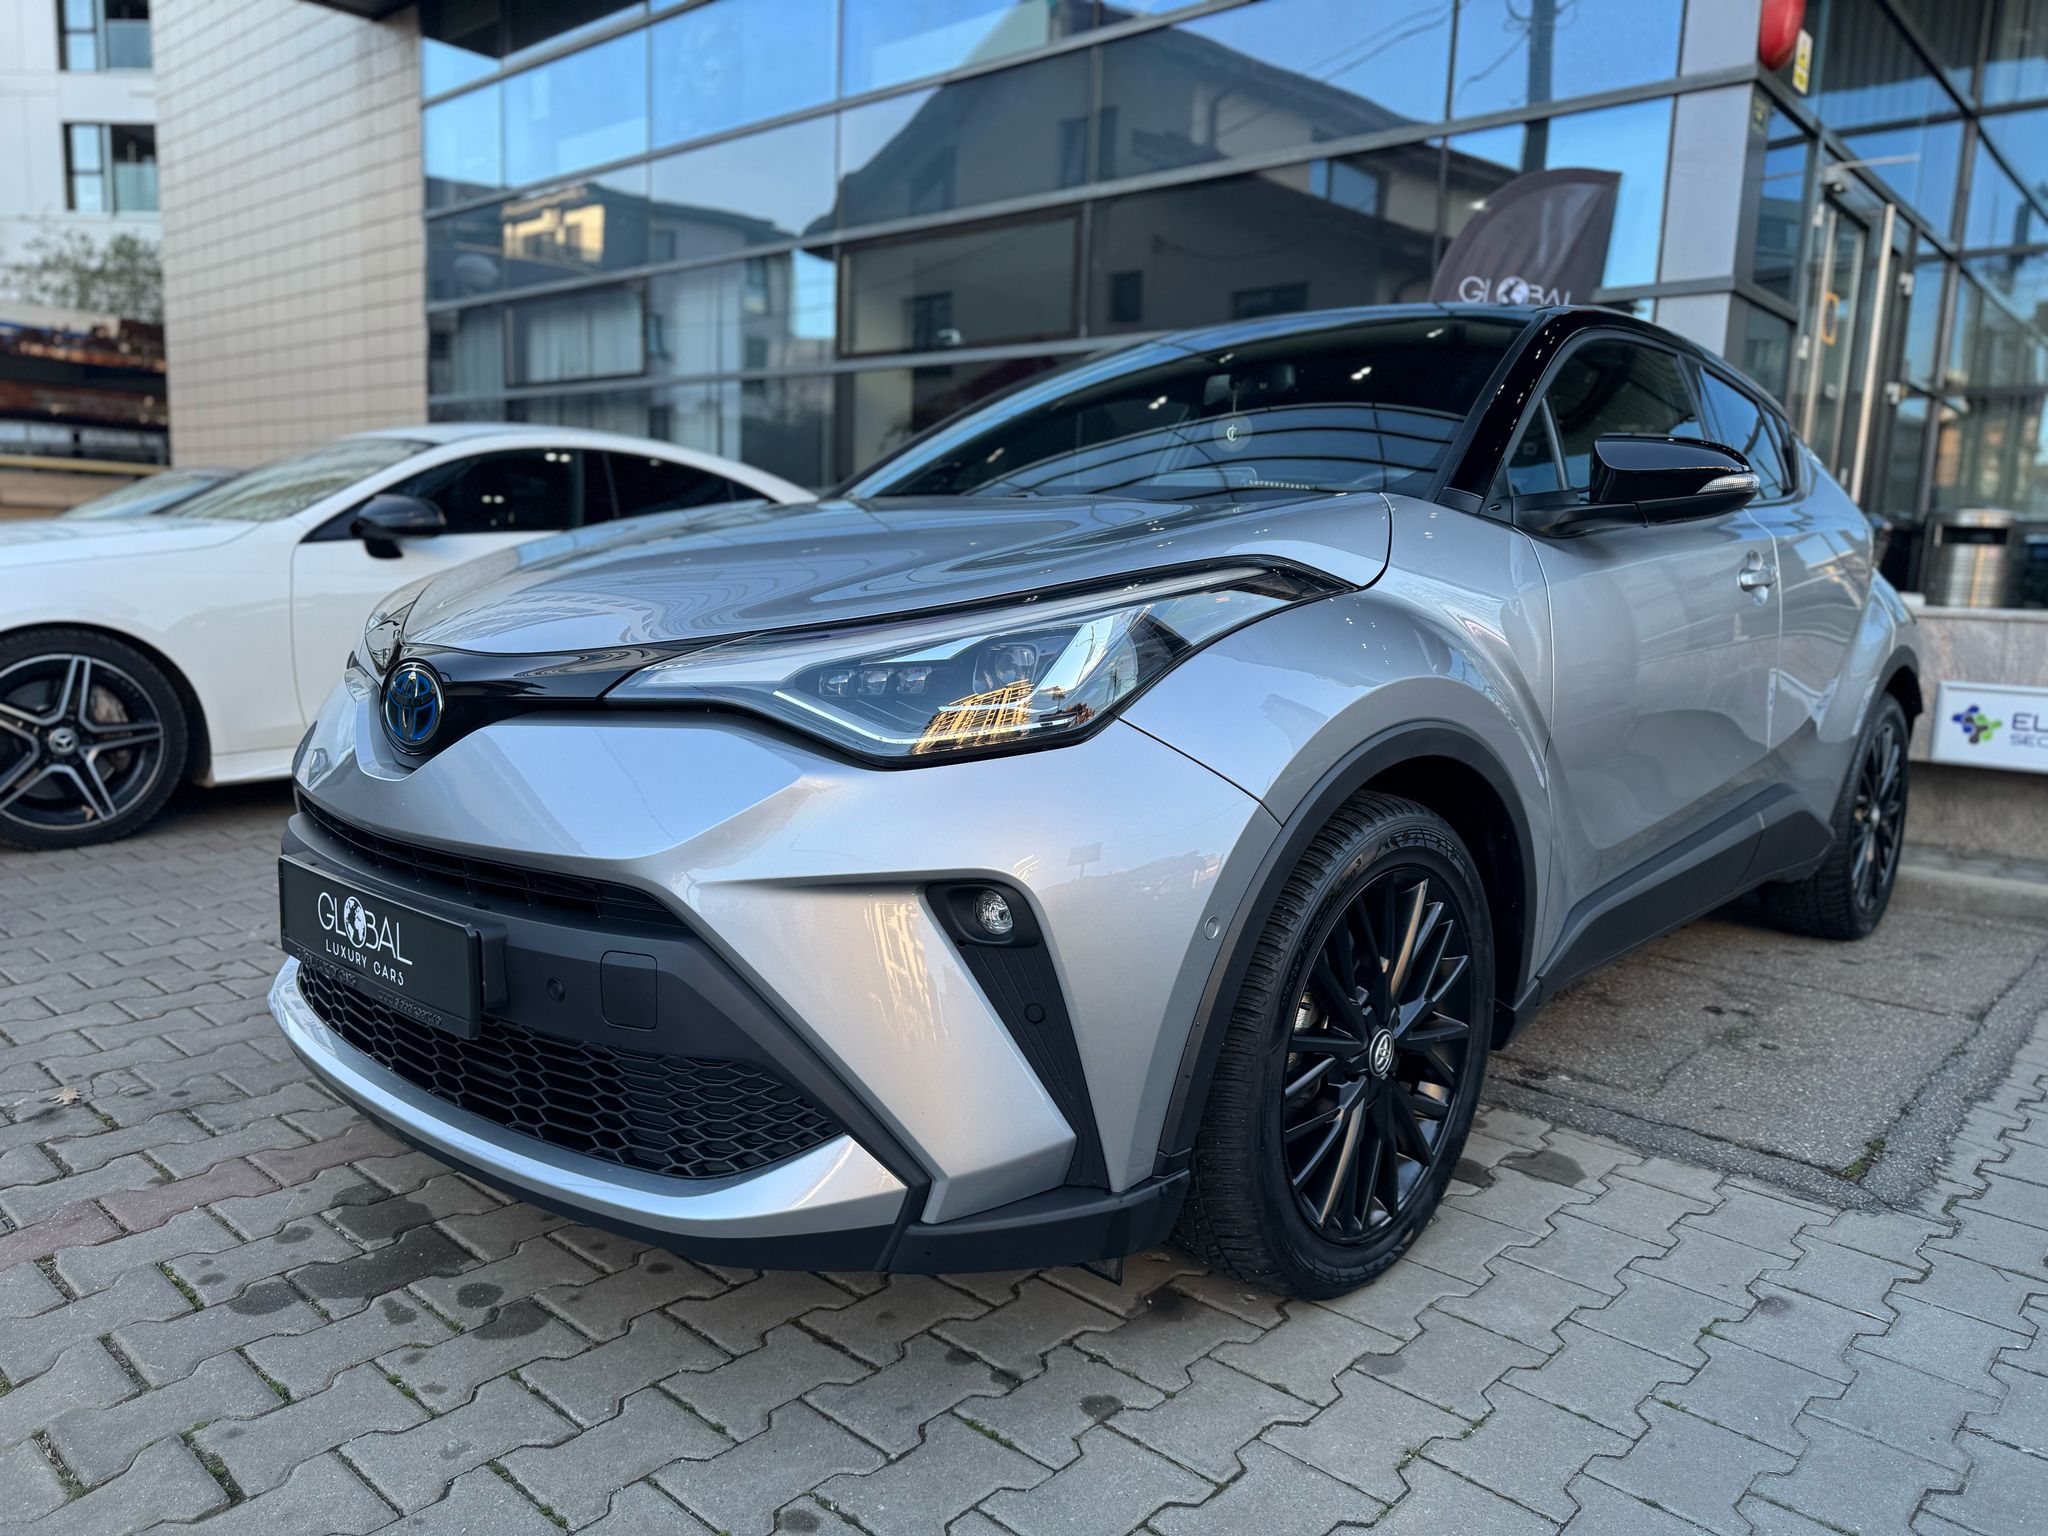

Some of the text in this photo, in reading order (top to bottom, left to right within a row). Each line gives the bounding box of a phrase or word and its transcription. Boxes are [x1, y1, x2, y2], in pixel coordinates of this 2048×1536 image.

[317, 892, 413, 965] GLOBAL
[325, 938, 368, 968] LUXURY
[373, 961, 405, 986] CARS
